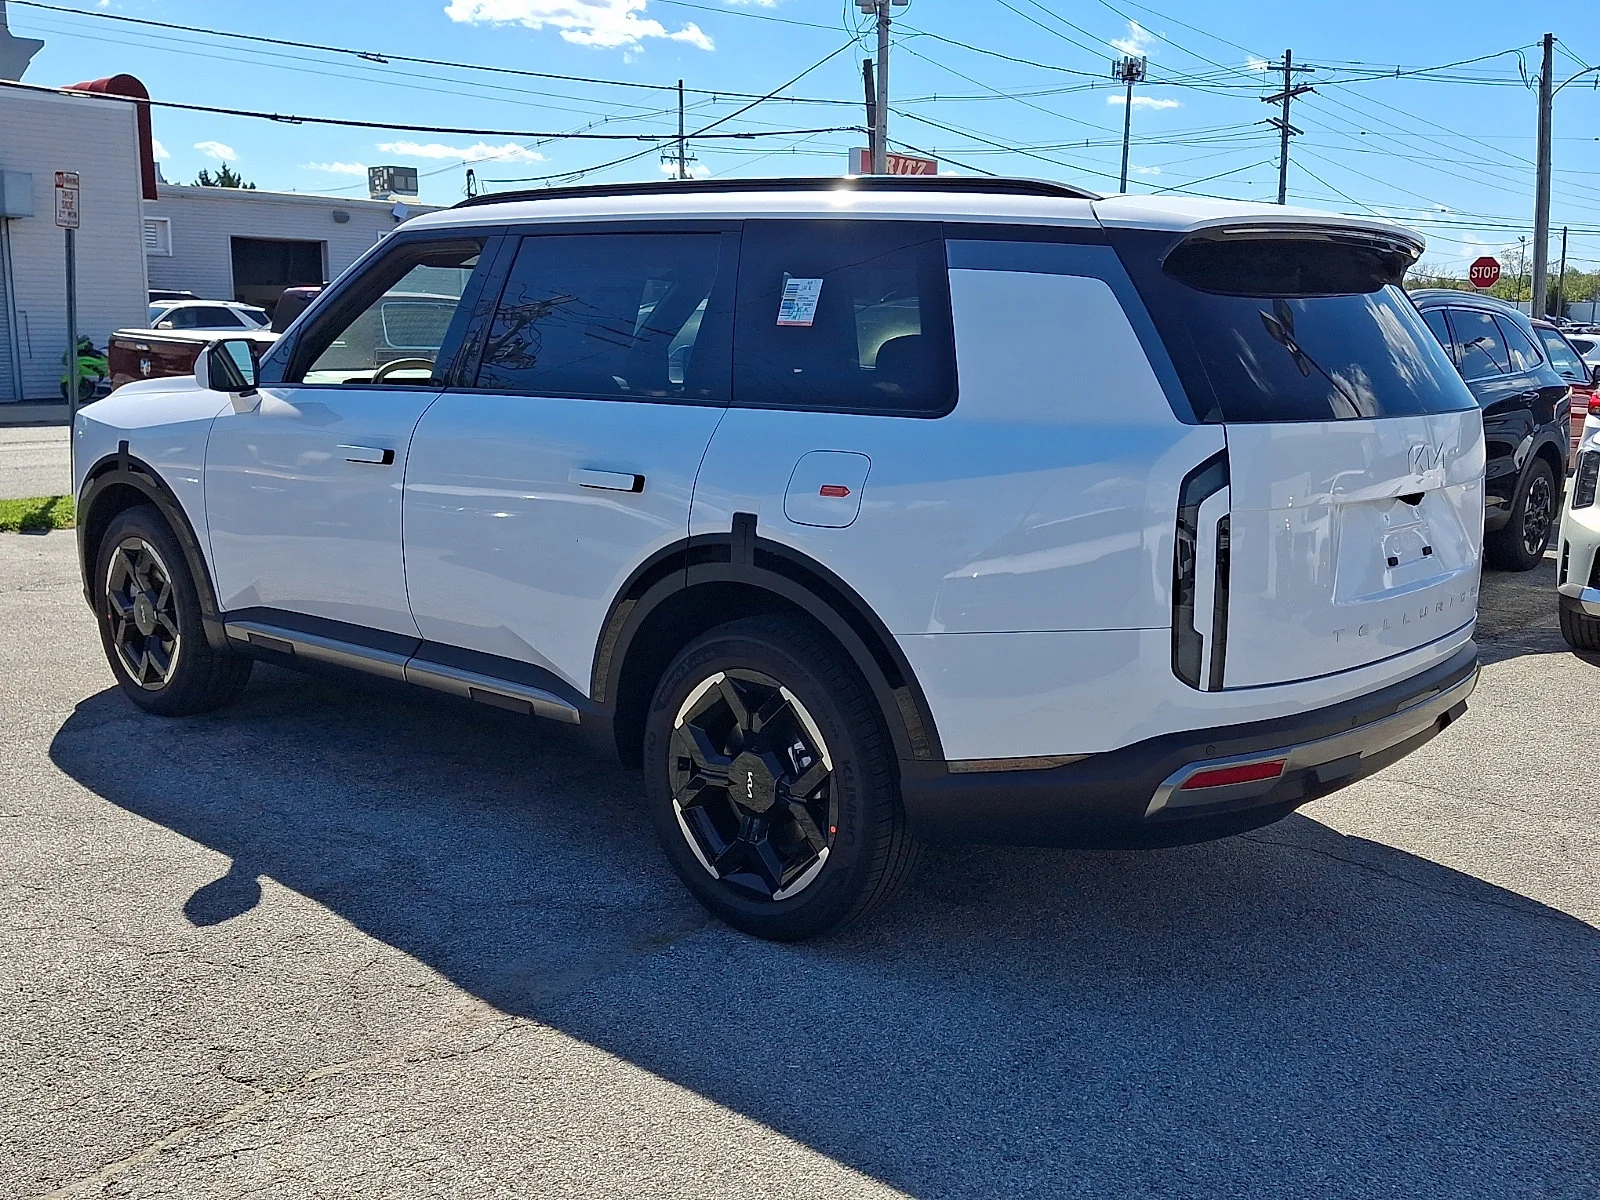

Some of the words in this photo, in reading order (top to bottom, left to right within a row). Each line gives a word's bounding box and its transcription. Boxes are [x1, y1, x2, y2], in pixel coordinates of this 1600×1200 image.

[62, 190, 74, 200] THIS
[62, 200, 74, 210] SIDE
[1471, 266, 1499, 279] STOP
[1332, 586, 1478, 643] TELLURIDE
